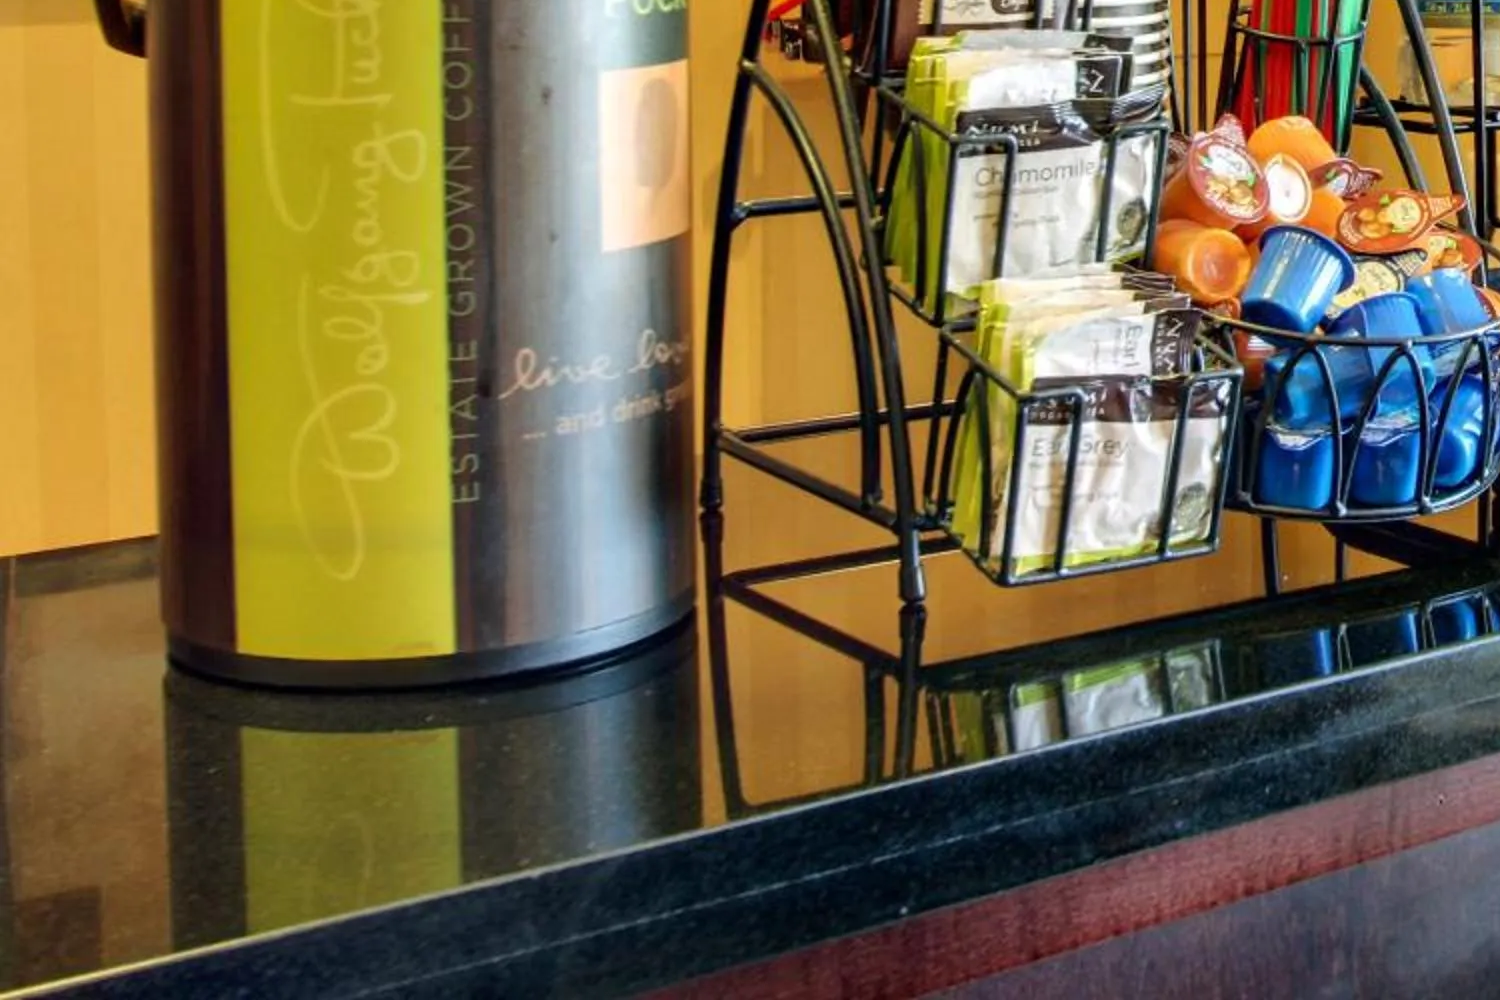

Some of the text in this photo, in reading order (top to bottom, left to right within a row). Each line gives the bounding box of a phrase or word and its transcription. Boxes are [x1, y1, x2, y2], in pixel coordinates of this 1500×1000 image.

[444, 146, 476, 317] GROWN
[975, 159, 1096, 187] Chmomile
[447, 339, 481, 504] ESTATE
